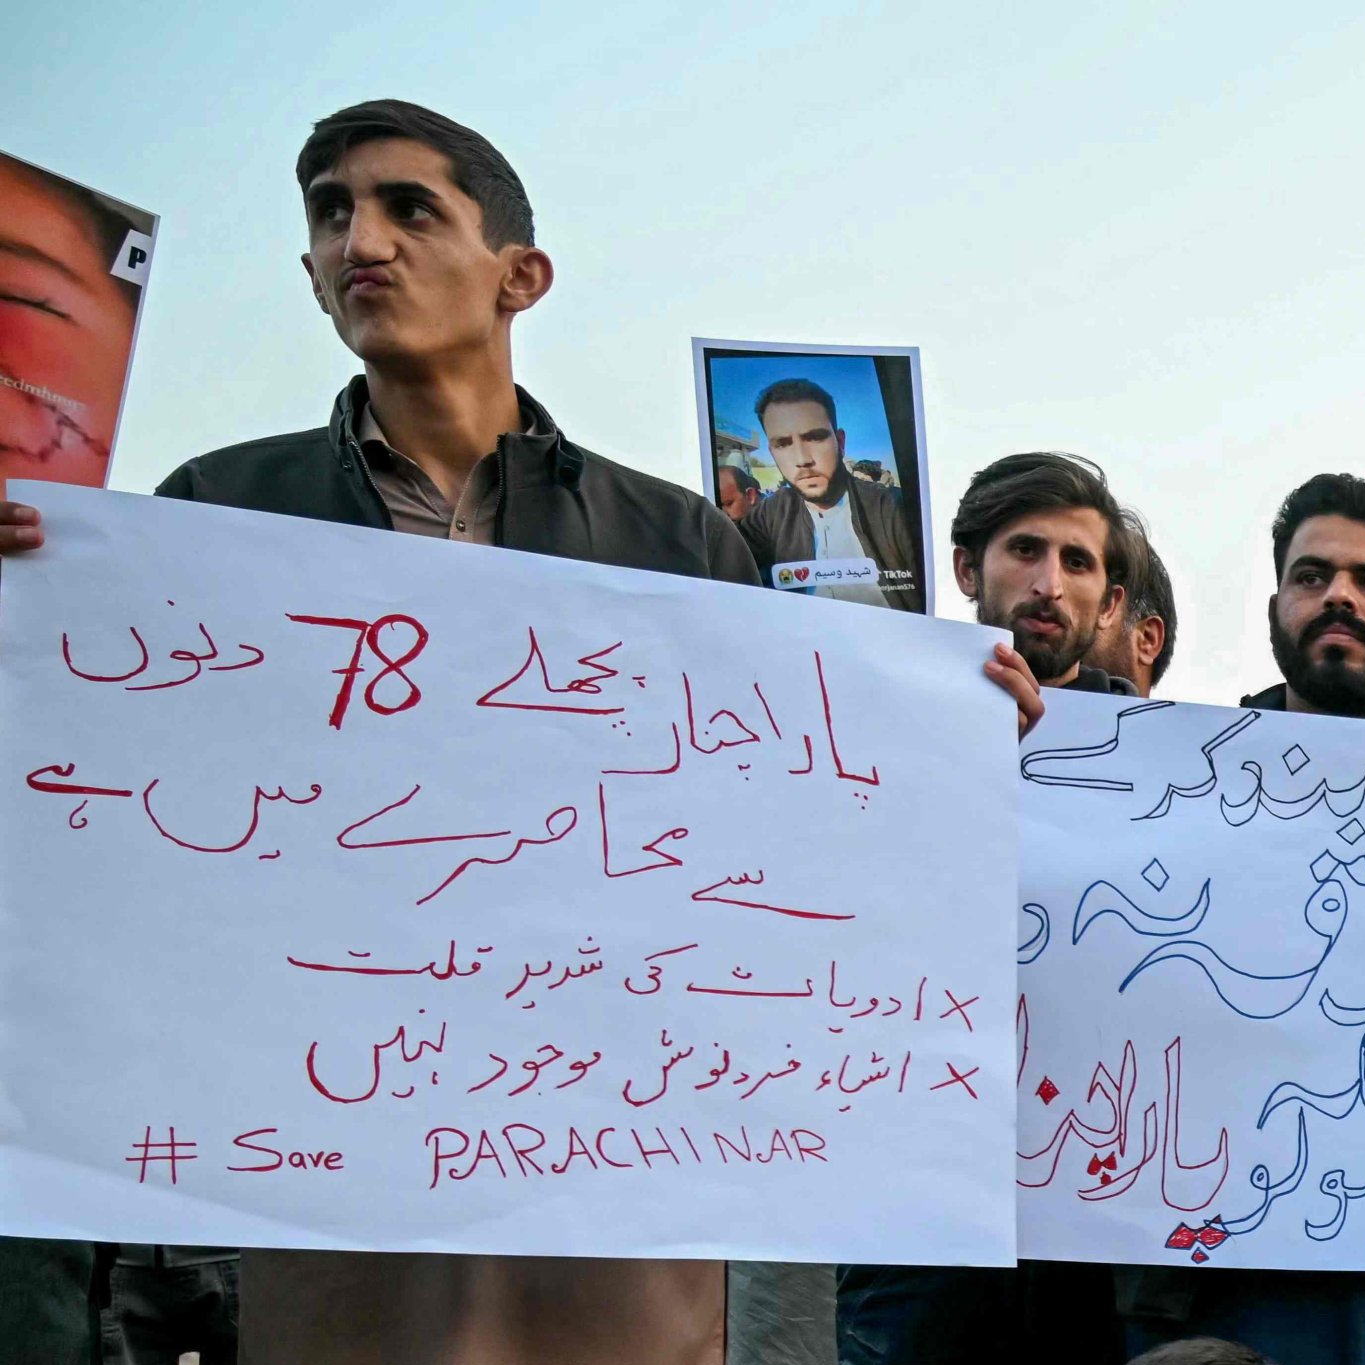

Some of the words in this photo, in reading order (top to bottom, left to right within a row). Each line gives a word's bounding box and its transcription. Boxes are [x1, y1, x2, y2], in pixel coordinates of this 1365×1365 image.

[814, 568, 842, 581] وسیم
[883, 570, 912, 580] TikTok
[62, 599, 265, 691] دنوں
[285, 613, 429, 731] 78
[26, 762, 134, 830] ہے
[143, 778, 323, 861] میں
[691, 870, 856, 920] سے
[286, 939, 494, 980] قلت
[504, 936, 603, 1009] شدید
[624, 943, 698, 995] کی
[306, 1009, 447, 1104] نہیں
[467, 1043, 602, 1097] موجود
[226, 1127, 345, 1173] Save
[425, 1122, 829, 1191] PARACHINAR
